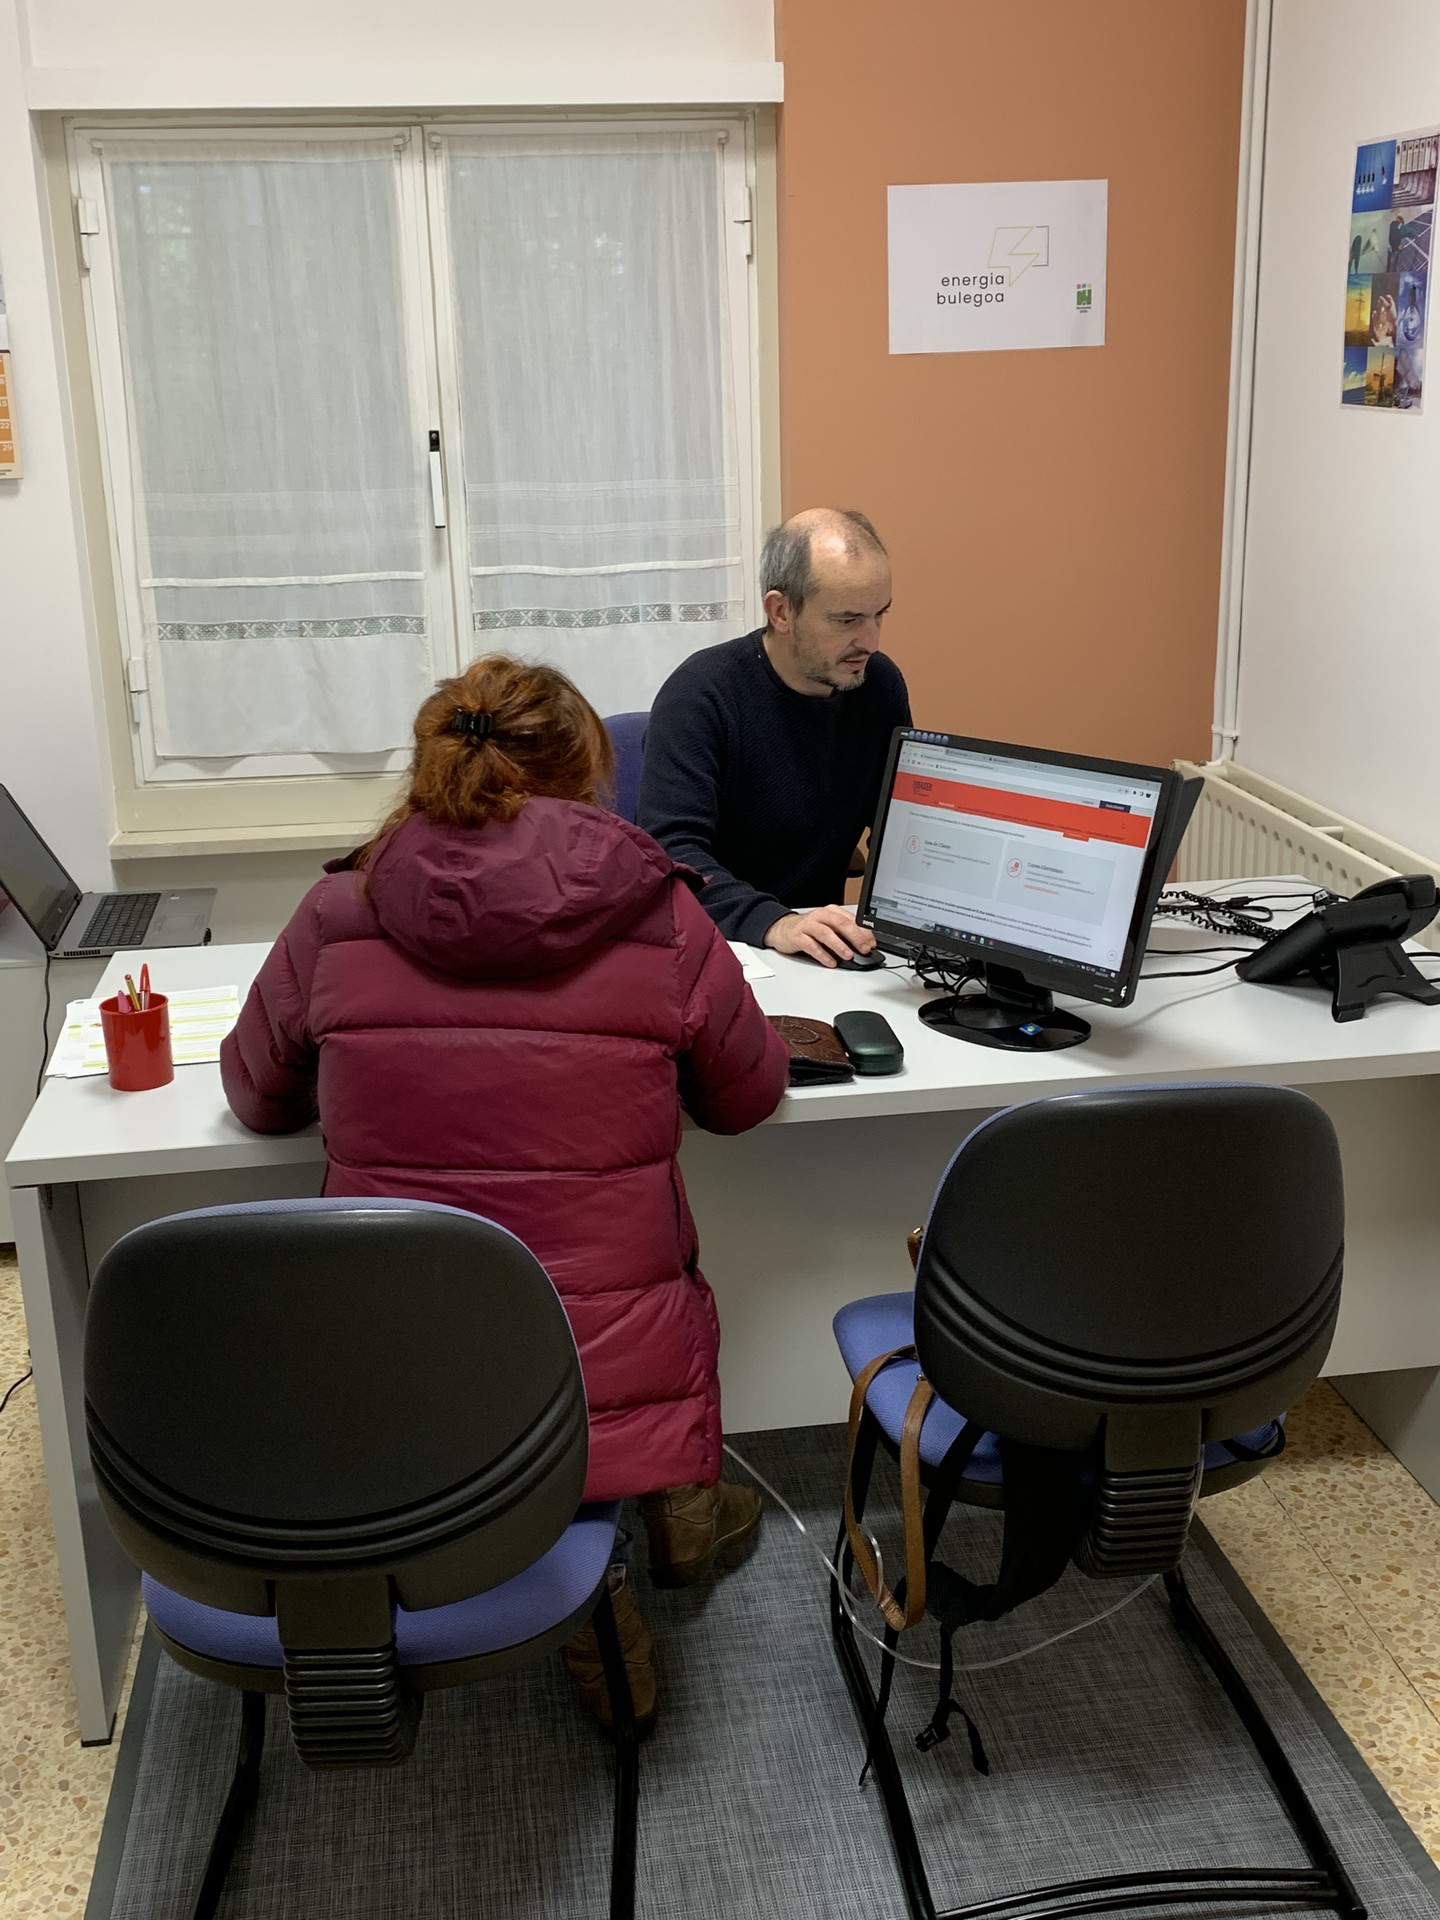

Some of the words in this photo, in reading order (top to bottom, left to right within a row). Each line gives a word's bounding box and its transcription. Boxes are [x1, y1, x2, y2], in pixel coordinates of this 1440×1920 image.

[941, 272, 1005, 290] energia
[936, 291, 1005, 307] bulegoa
[2, 444, 12, 452] 29
